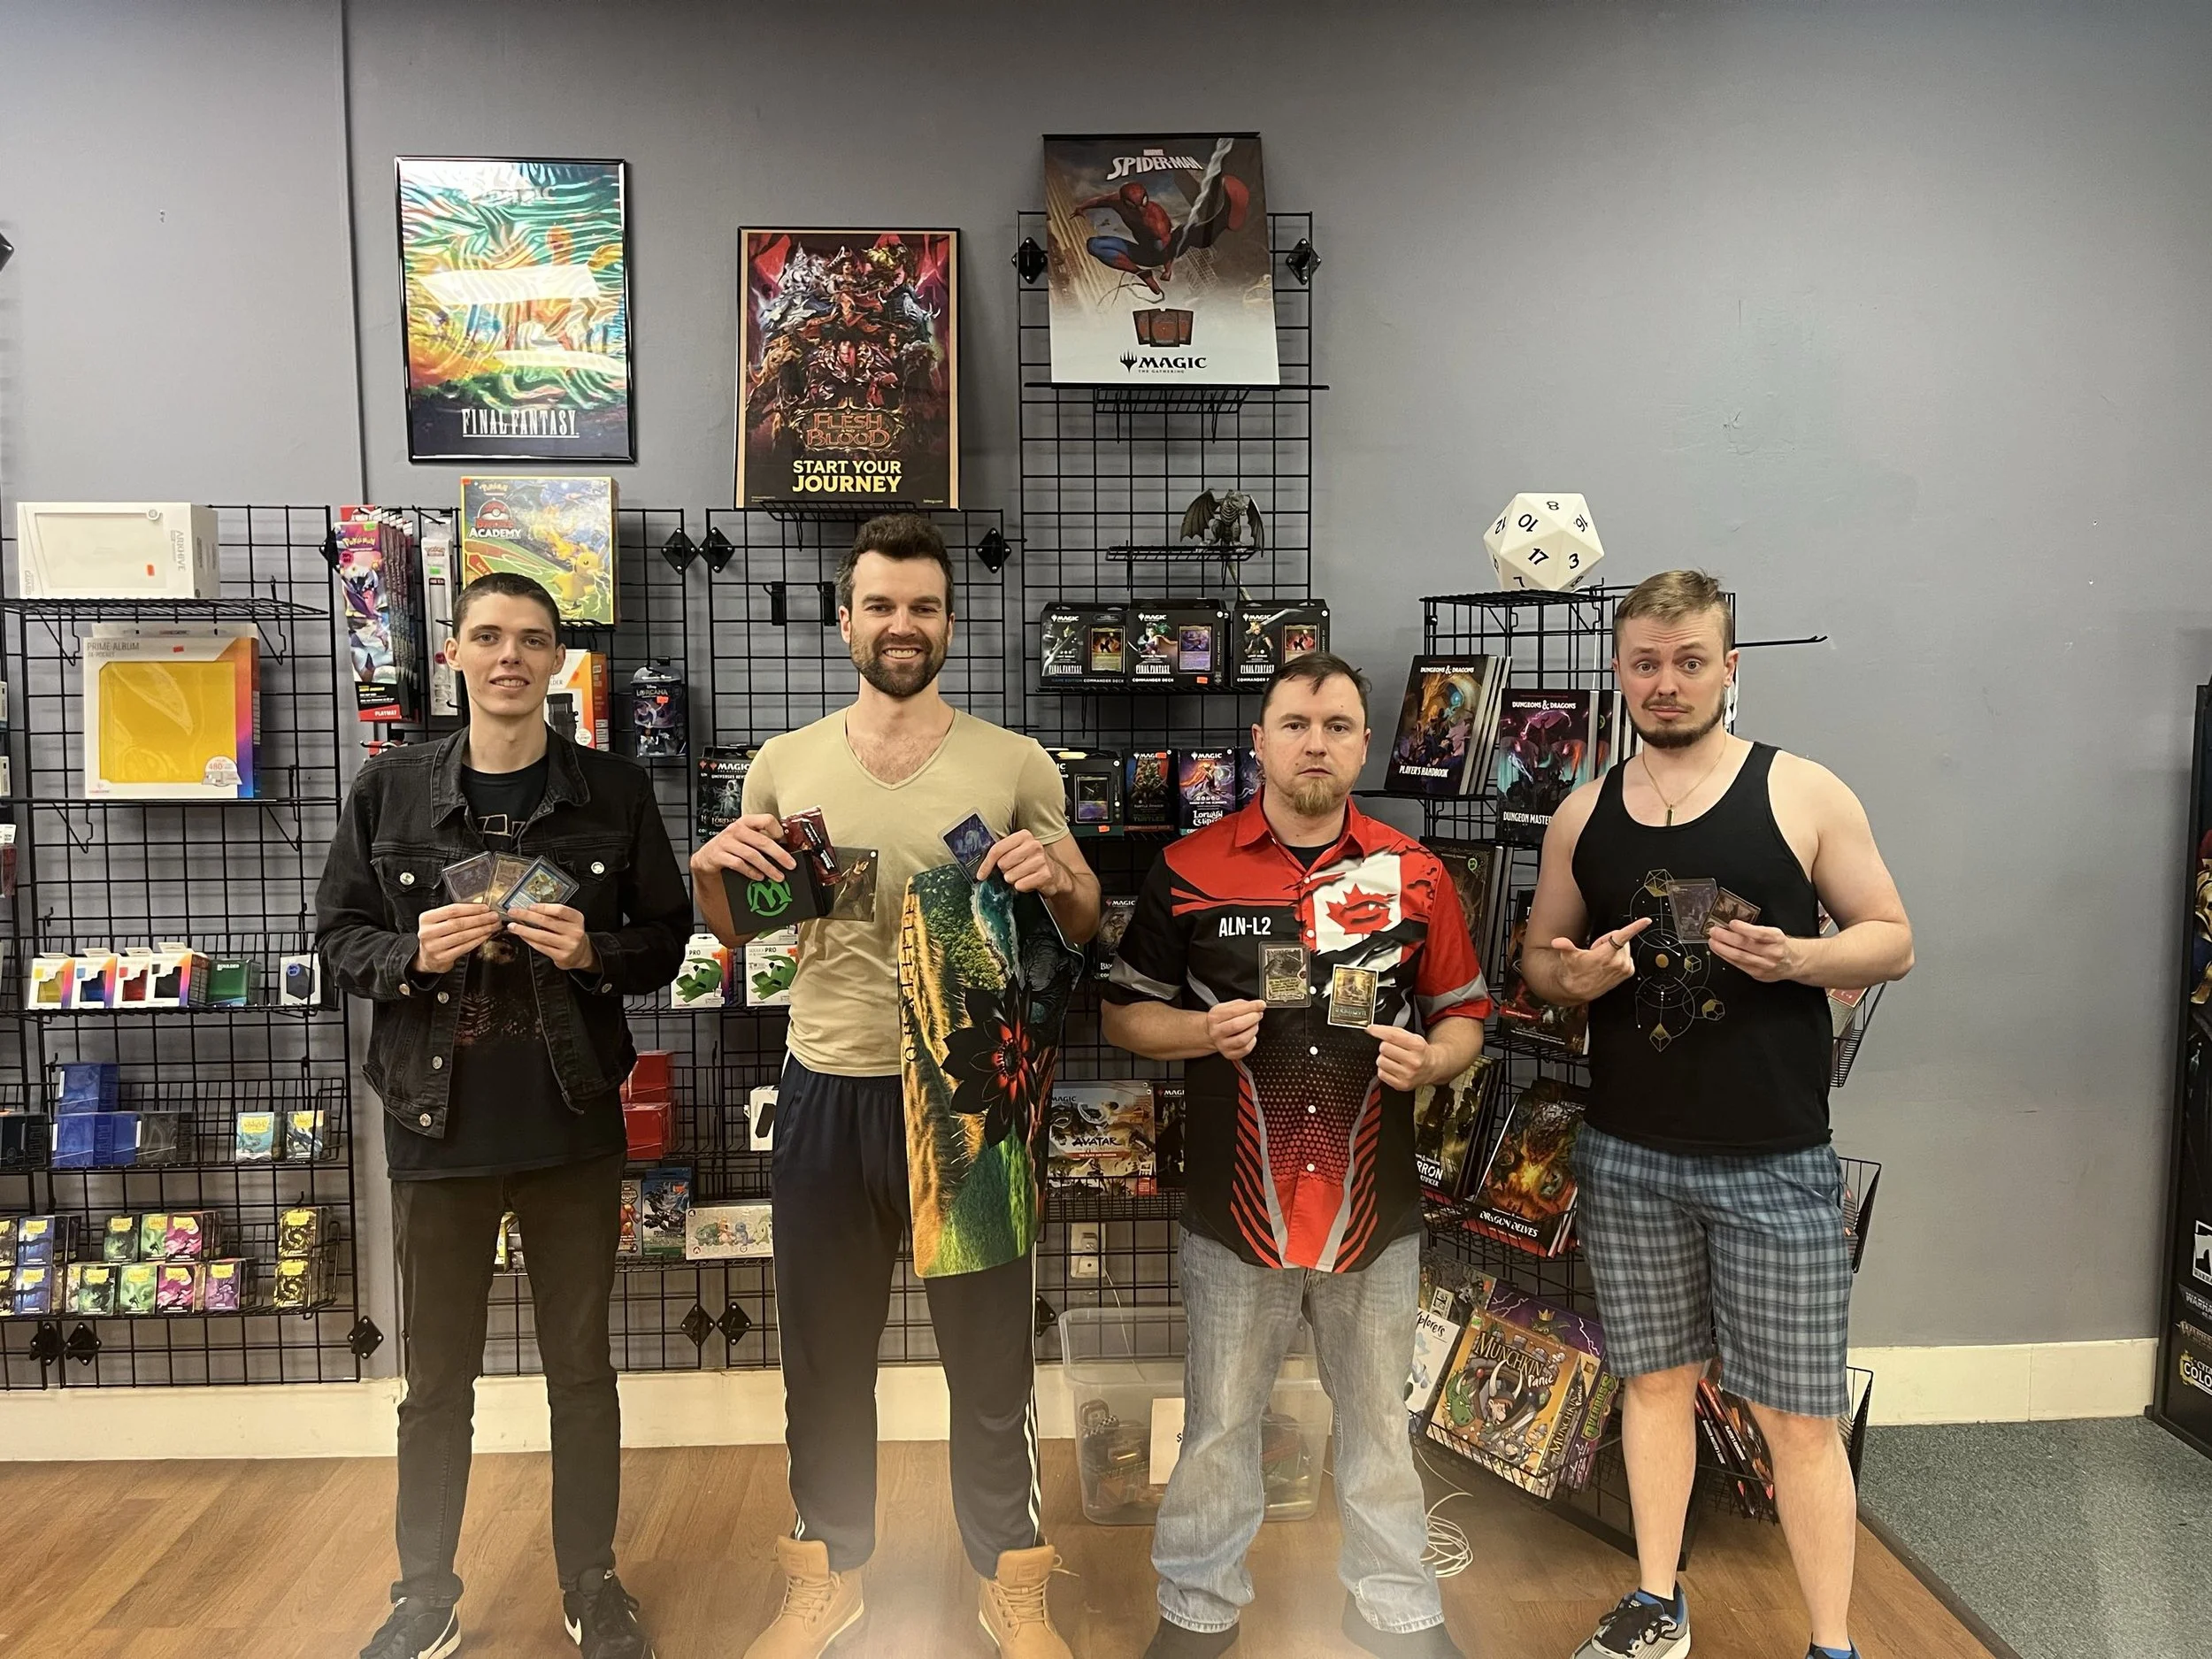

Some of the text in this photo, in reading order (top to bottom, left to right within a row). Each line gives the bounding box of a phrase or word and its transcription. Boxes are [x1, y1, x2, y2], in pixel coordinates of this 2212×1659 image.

[1106, 156, 1203, 180] SPIDER-MAN
[1138, 357, 1207, 369] MAGIC
[461, 409, 577, 435] FINAL FANTASY
[813, 412, 882, 430] FLESH
[806, 428, 890, 447] BLOOD
[793, 460, 902, 474] START YOUR
[792, 474, 902, 493] JOURNEY
[1547, 501, 1560, 511] 8
[1518, 514, 1539, 532] 10
[469, 526, 522, 539] ACADEMY
[176, 531, 186, 571] ARKHIVE
[1527, 548, 1549, 565] 17
[1569, 553, 1579, 569] 3
[87, 641, 140, 651] PRIME ALBUM
[1512, 701, 1541, 710] DUNGEONS
[1420, 766, 1448, 778] HANDBOOK
[1503, 811, 1529, 823] DUNGEON
[1218, 916, 1271, 938] ALN-L2
[1071, 1137, 1123, 1147] AVATAR
[1479, 1210, 1511, 1228] DRAGON
[1510, 1222, 1539, 1238] DELVES
[1476, 1331, 1543, 1377] MUNCHKIN
[1527, 1373, 1555, 1388] Panic
[1549, 1393, 1577, 1456] MUNCHKIN
